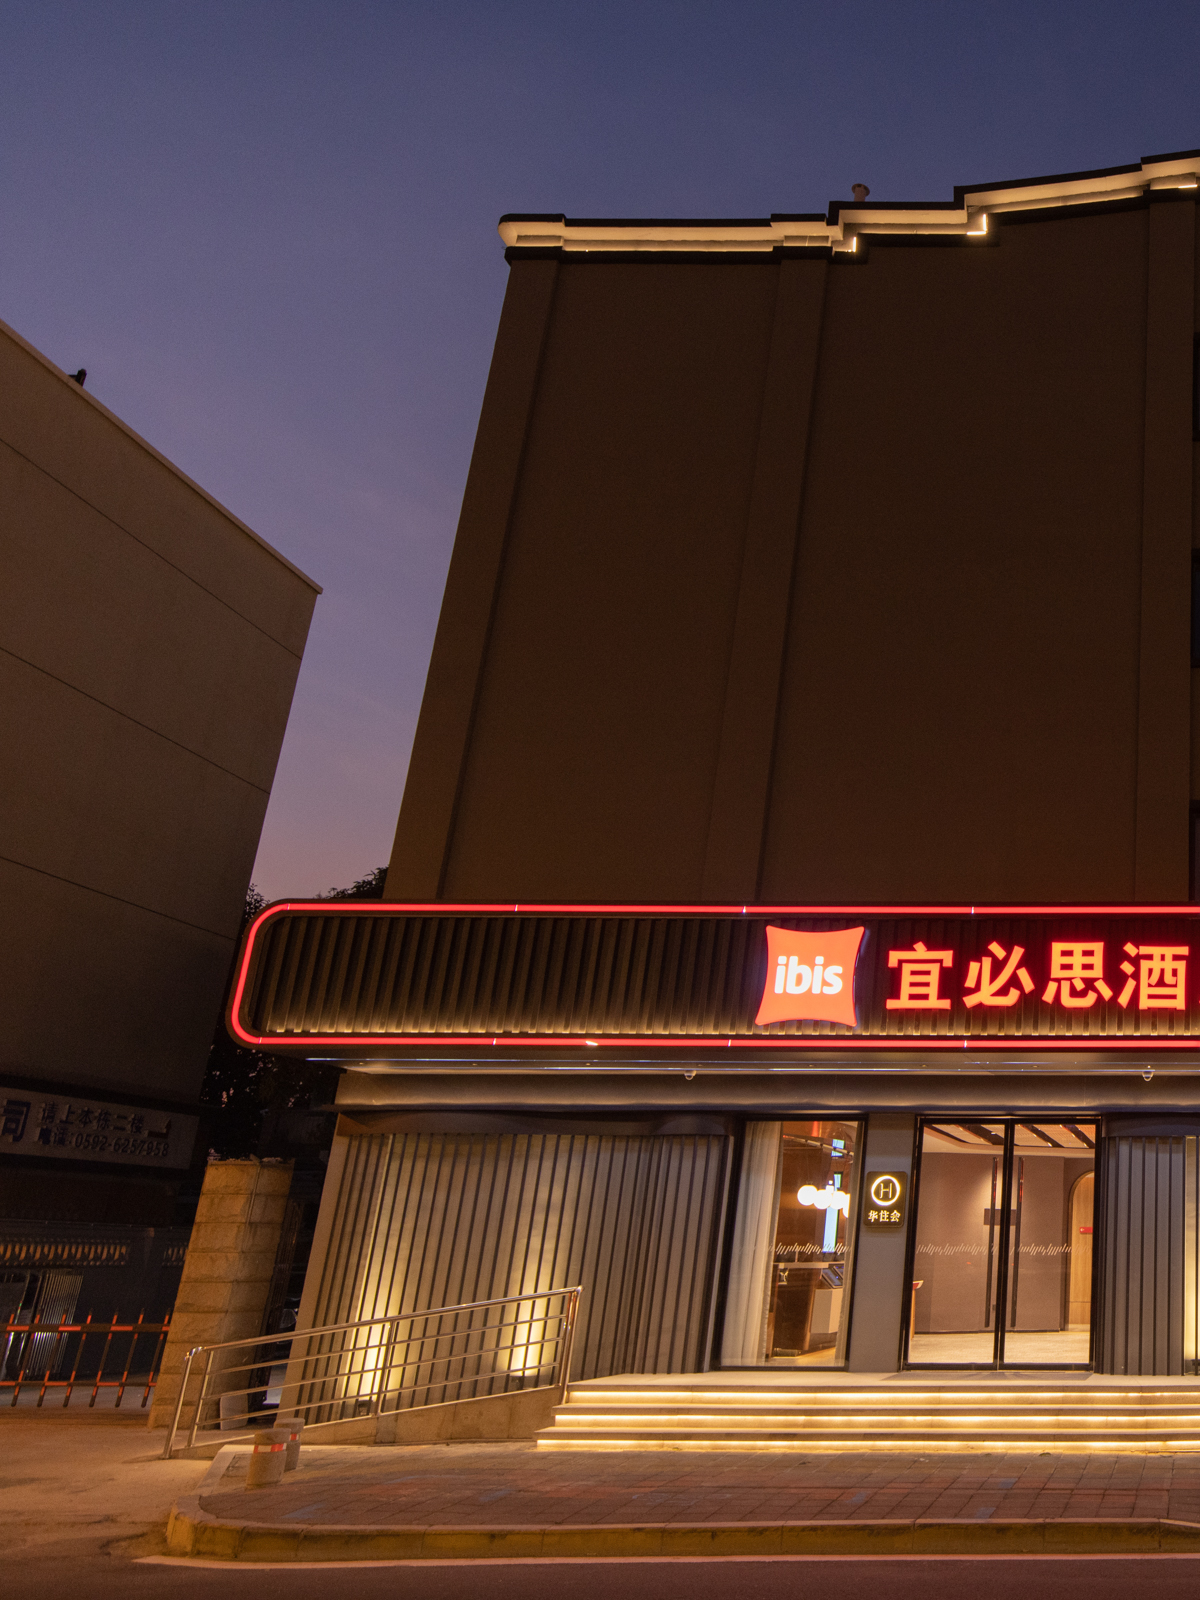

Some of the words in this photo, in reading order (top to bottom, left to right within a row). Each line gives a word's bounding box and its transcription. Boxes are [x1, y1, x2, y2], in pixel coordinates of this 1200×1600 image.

[774, 956, 843, 995] ibis
[868, 1210, 901, 1223] 华住会
